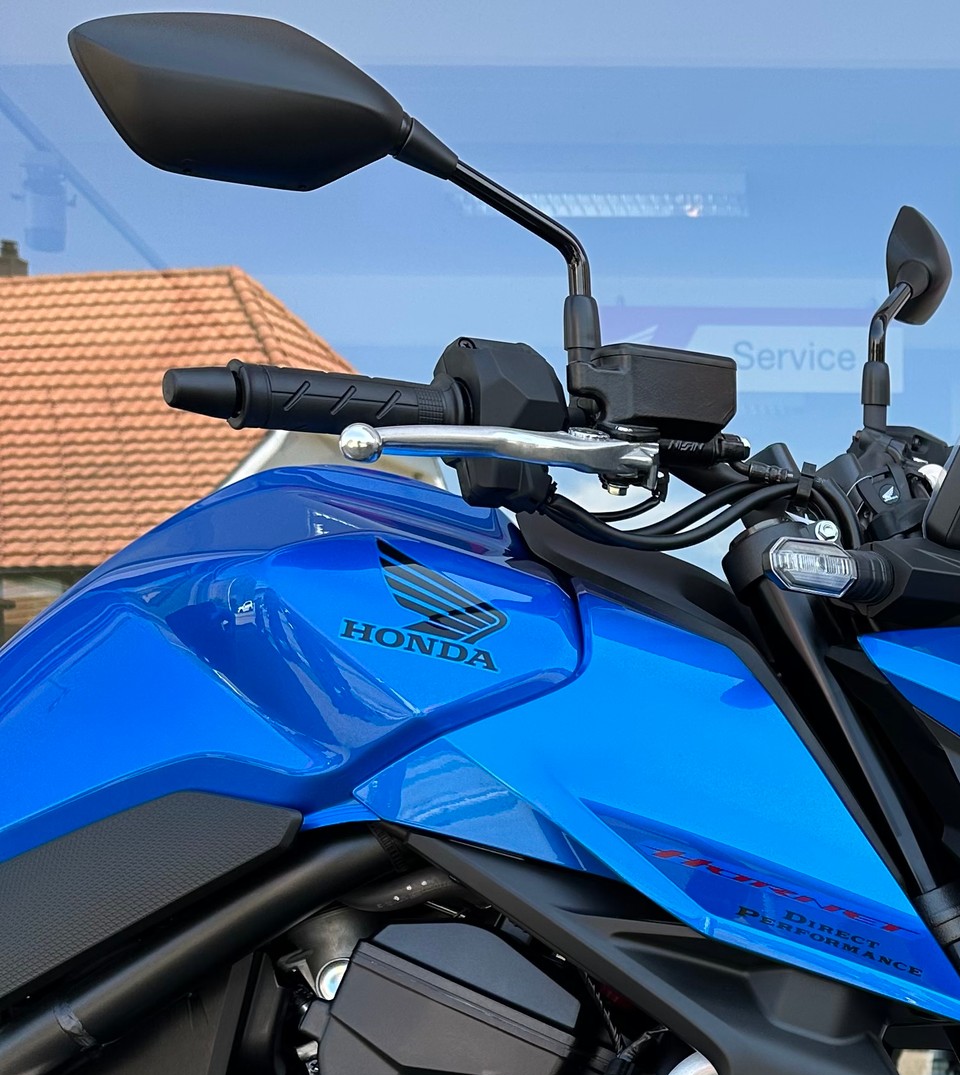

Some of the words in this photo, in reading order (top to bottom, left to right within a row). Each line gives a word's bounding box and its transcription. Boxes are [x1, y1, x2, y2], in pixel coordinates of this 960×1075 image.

[734, 341, 856, 372] Service
[341, 619, 499, 672] HONDA
[648, 846, 920, 935] HORNET
[736, 905, 924, 978] PERFORMANCE
[784, 909, 880, 949] DIRECT
